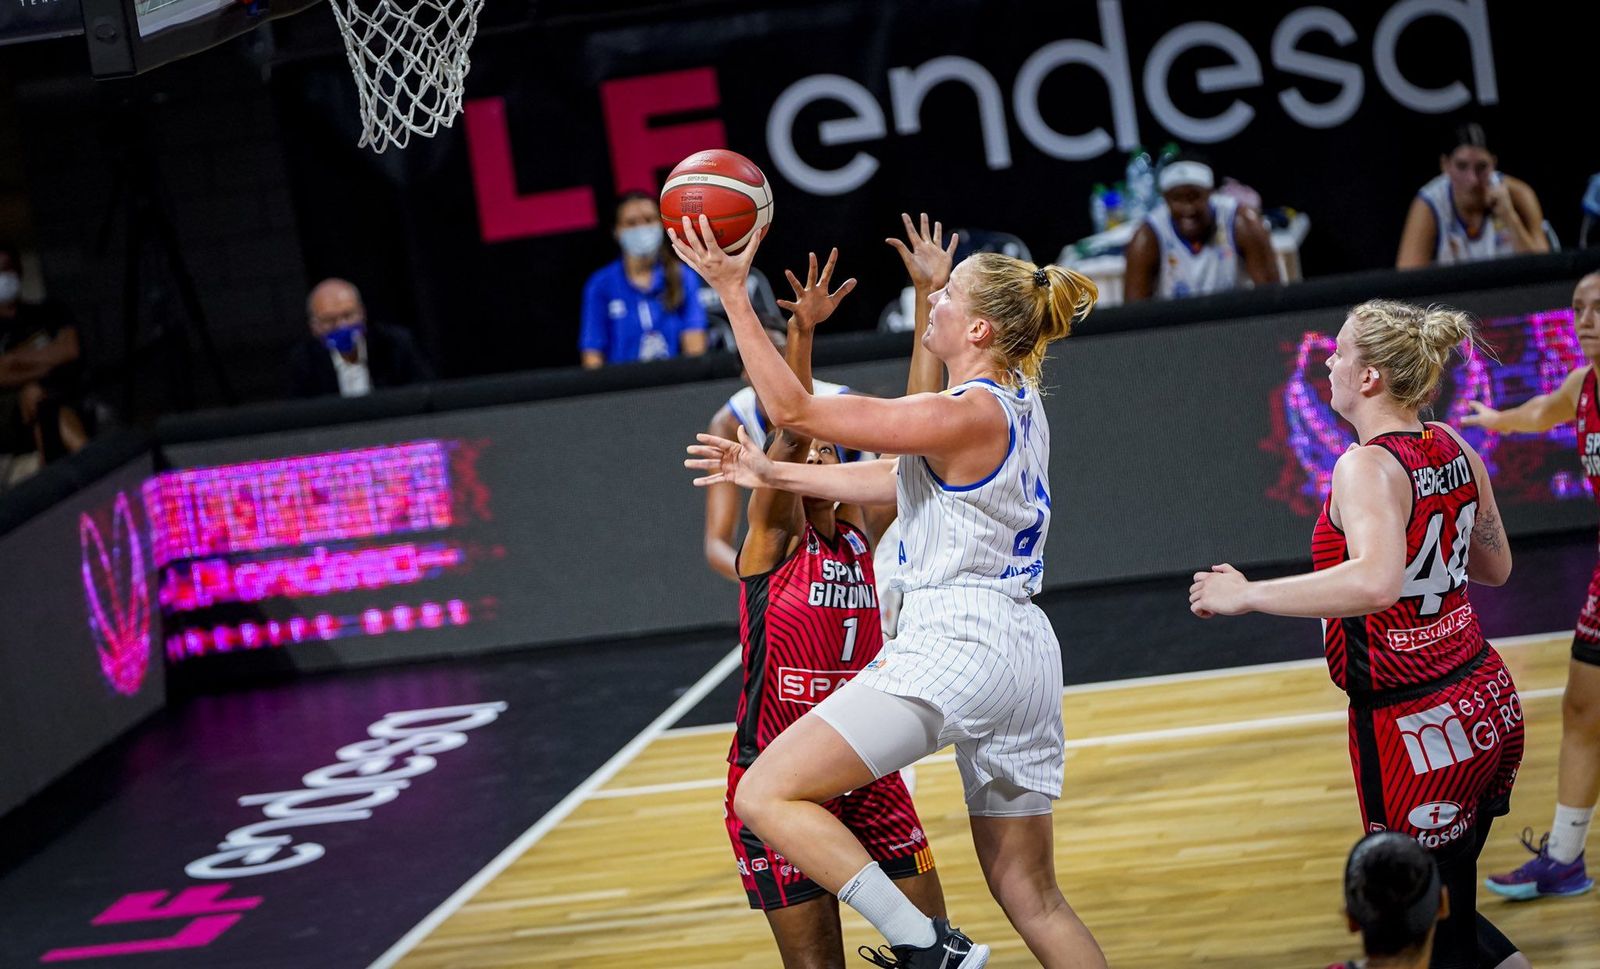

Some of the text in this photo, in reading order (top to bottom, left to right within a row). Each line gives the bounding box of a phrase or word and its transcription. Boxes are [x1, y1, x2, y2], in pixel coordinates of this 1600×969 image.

[465, 0, 1498, 244] LF endesa
[1400, 501, 1477, 615] 40
[841, 617, 858, 662] 1
[185, 701, 507, 879] endesa
